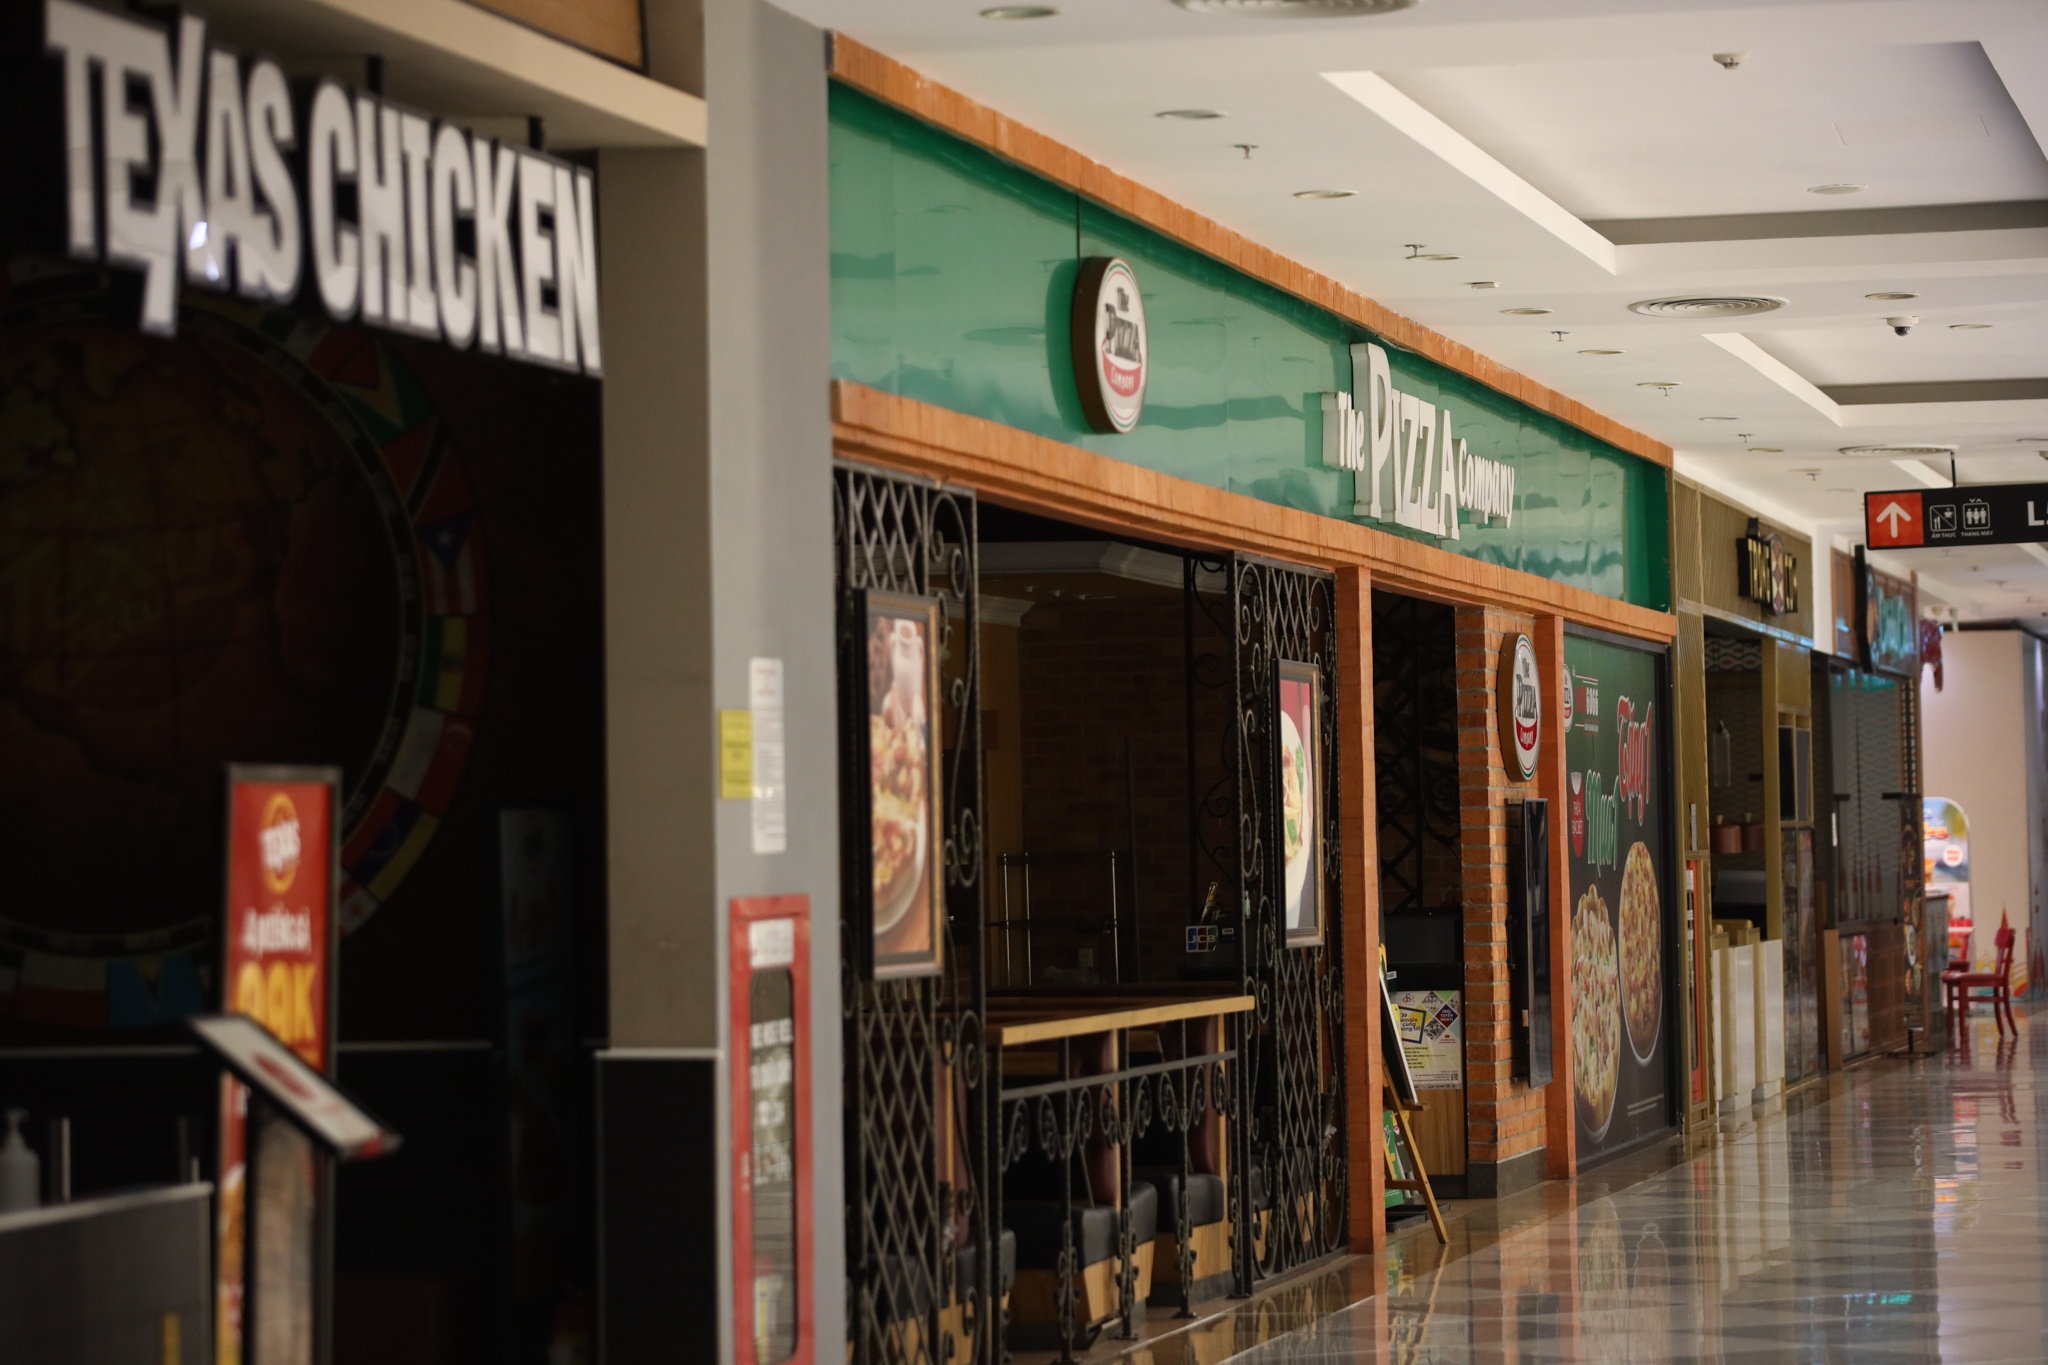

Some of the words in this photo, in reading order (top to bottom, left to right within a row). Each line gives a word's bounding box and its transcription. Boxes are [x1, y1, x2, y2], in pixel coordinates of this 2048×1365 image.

[45, 0, 301, 337] TEXAS
[309, 79, 603, 378] CHICKEN
[1105, 303, 1141, 363] PIZZA
[1330, 391, 1365, 472] The
[1351, 342, 1460, 541] PIZZA
[1458, 436, 1515, 529] Company
[2027, 500, 2048, 526] L
[1188, 935, 1216, 943] JCB
